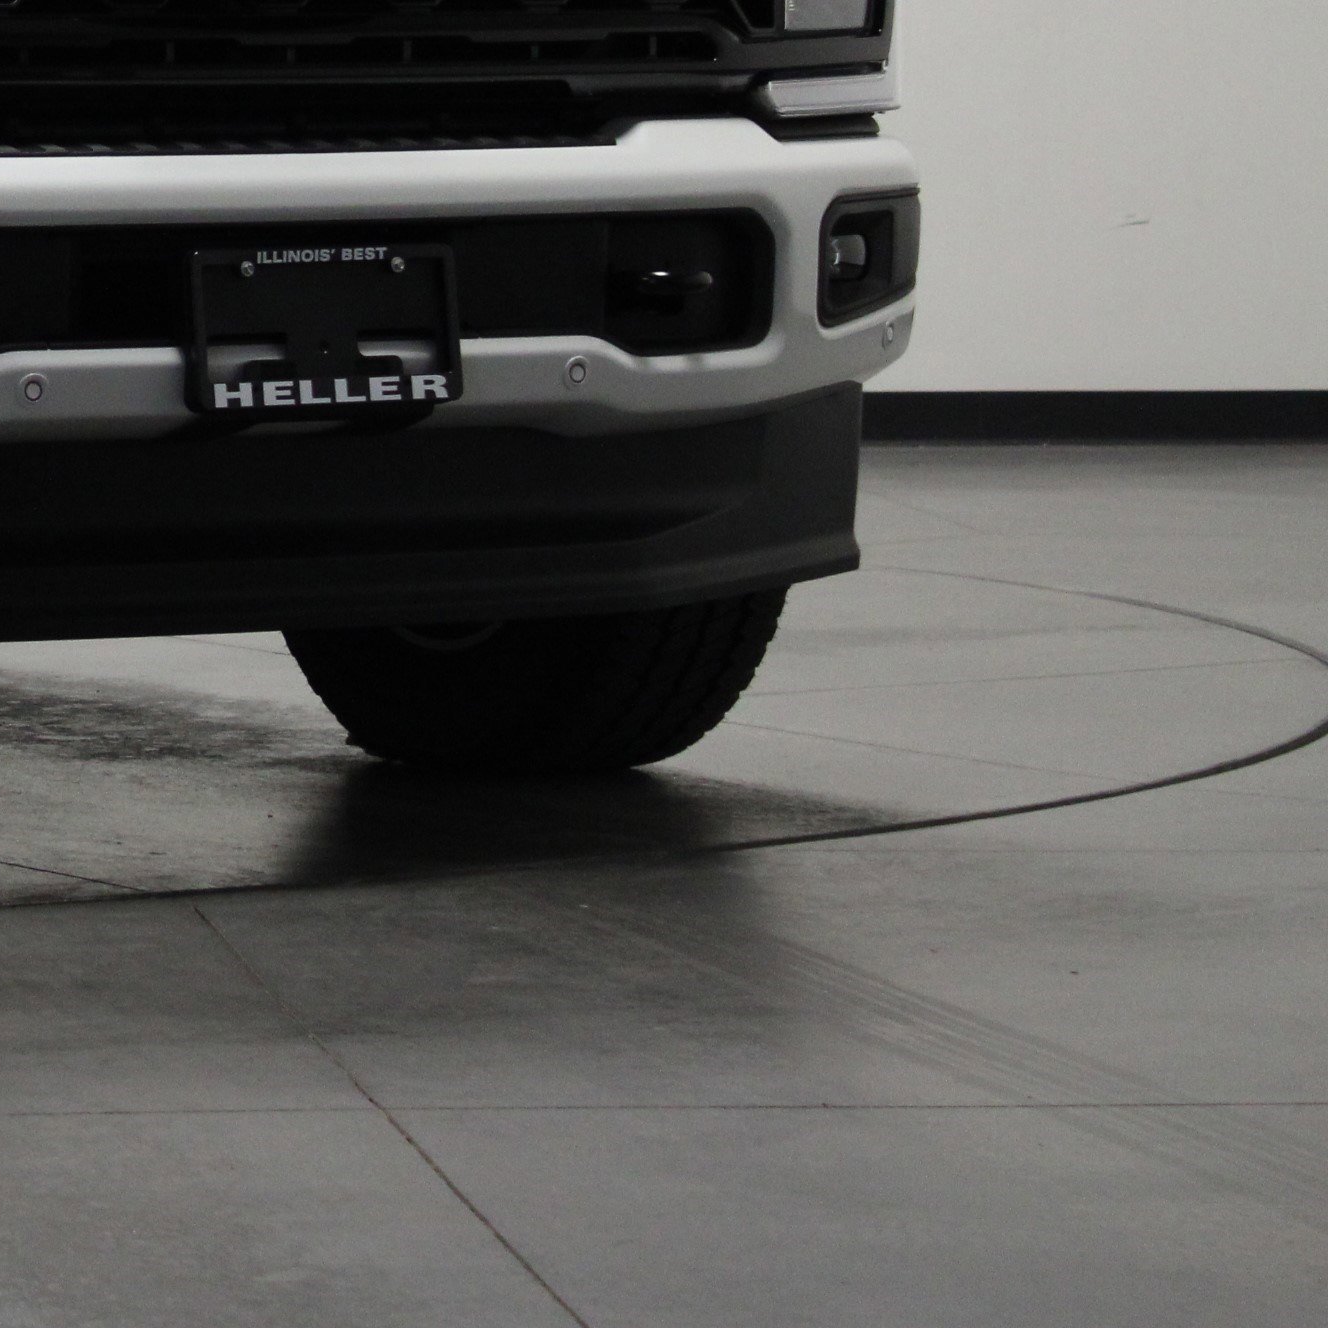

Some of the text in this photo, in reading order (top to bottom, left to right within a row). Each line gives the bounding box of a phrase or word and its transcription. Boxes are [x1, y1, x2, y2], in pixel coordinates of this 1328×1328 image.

[257, 246, 388, 264] ILLINOIS' BEST
[213, 374, 449, 408] HELLER
